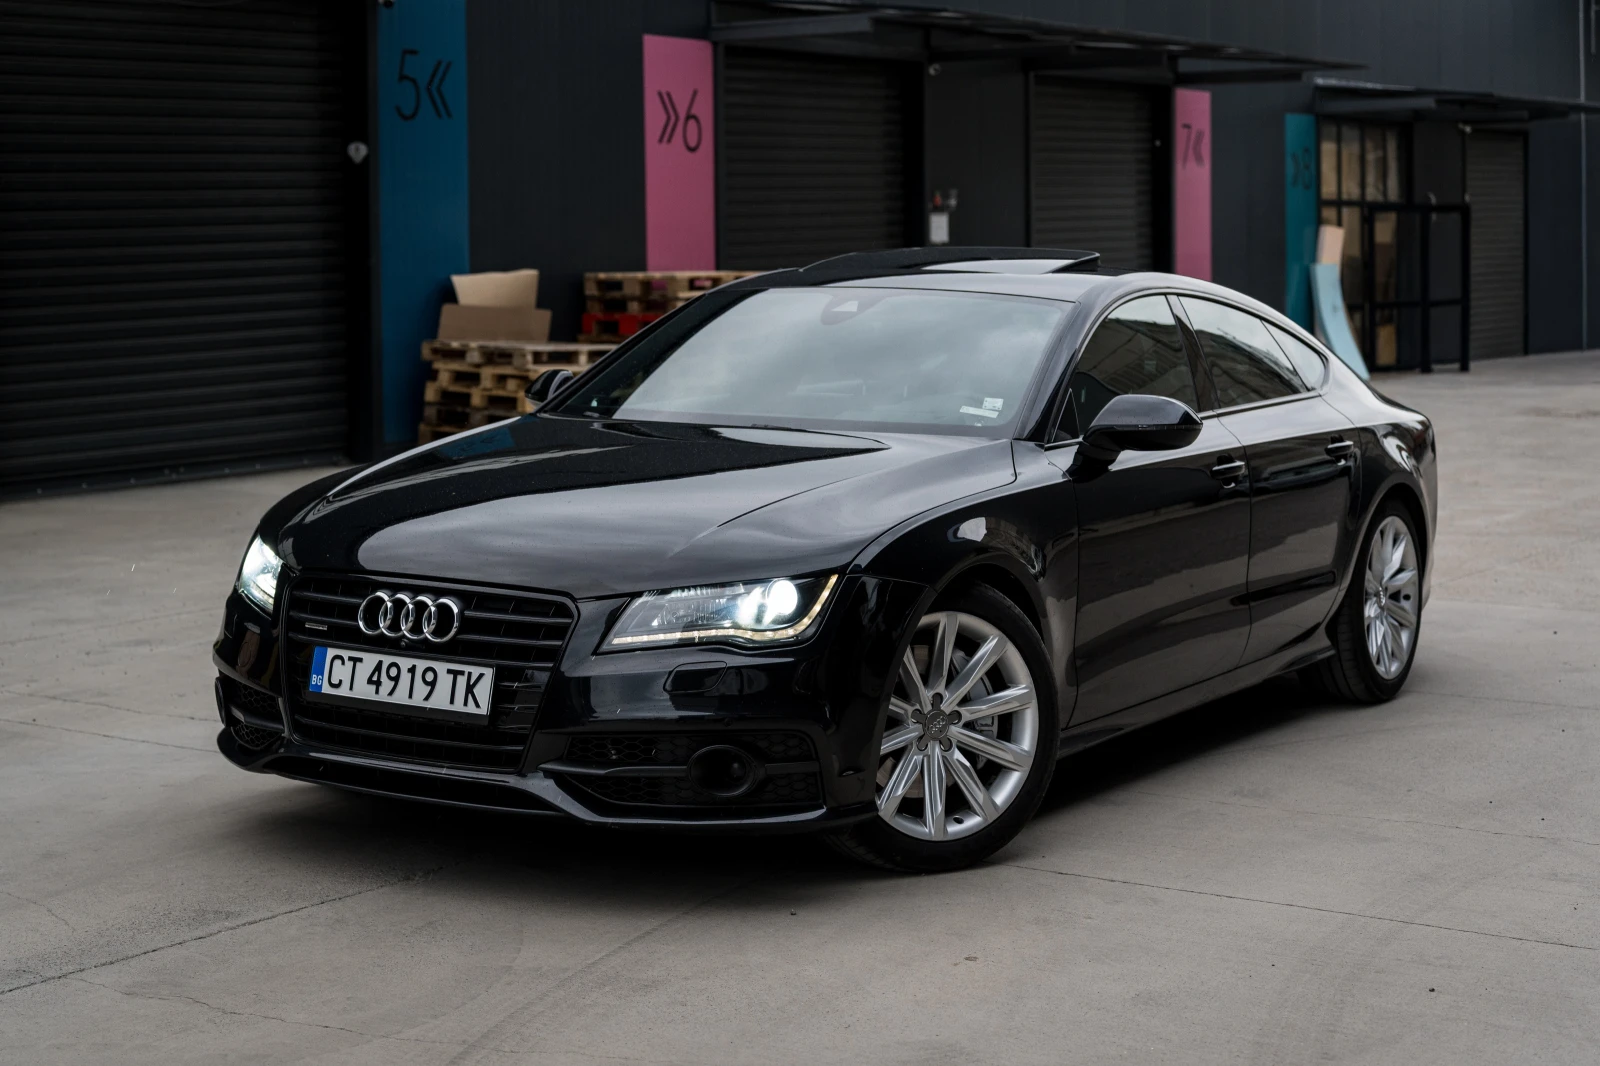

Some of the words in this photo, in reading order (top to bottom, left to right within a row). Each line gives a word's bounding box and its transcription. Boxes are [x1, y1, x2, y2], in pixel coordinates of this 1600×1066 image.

[311, 674, 322, 686] BG
[327, 654, 363, 691] CT
[367, 659, 438, 702] 4919
[446, 668, 486, 709] TK
